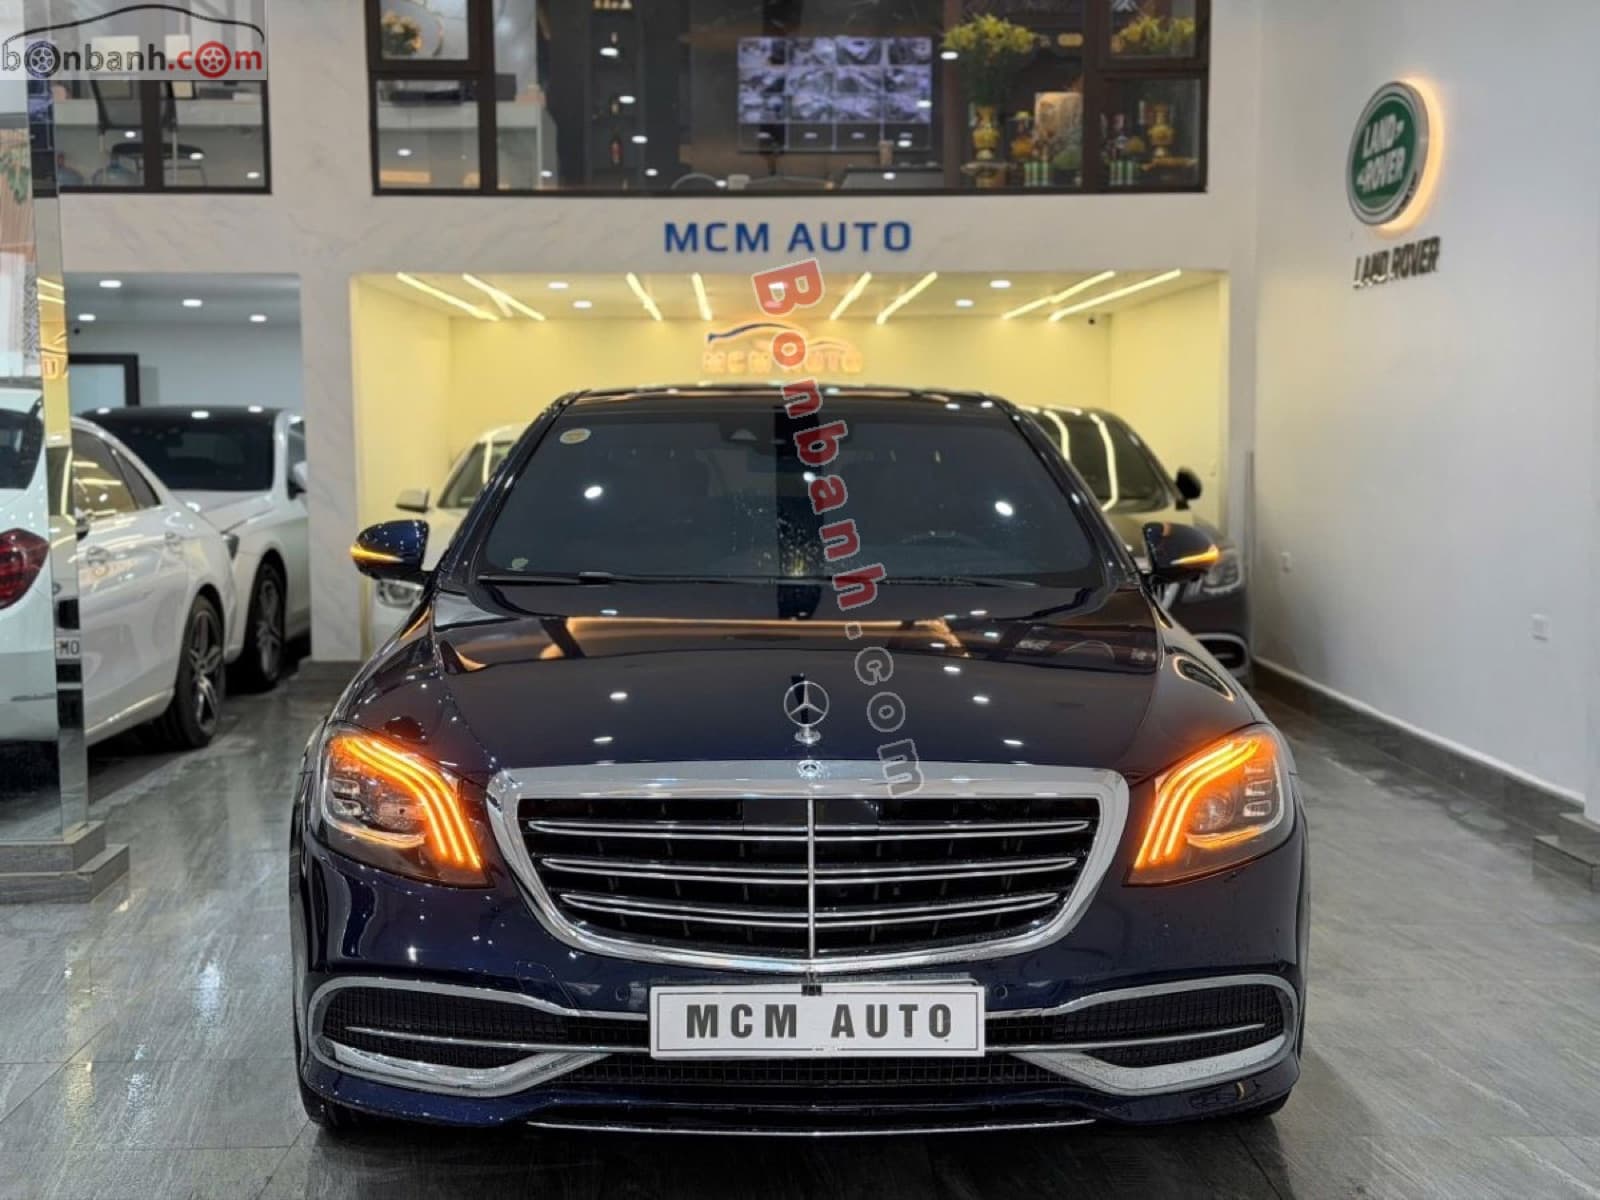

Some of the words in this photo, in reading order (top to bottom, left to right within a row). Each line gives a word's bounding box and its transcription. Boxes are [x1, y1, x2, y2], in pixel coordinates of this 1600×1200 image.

[664, 222, 770, 252] MCM
[787, 221, 913, 252] AUTO
[1353, 250, 1390, 289] LAND
[1390, 236, 1441, 279] ROVER
[686, 1003, 797, 1039] MCM
[831, 1003, 952, 1039] AUTO
